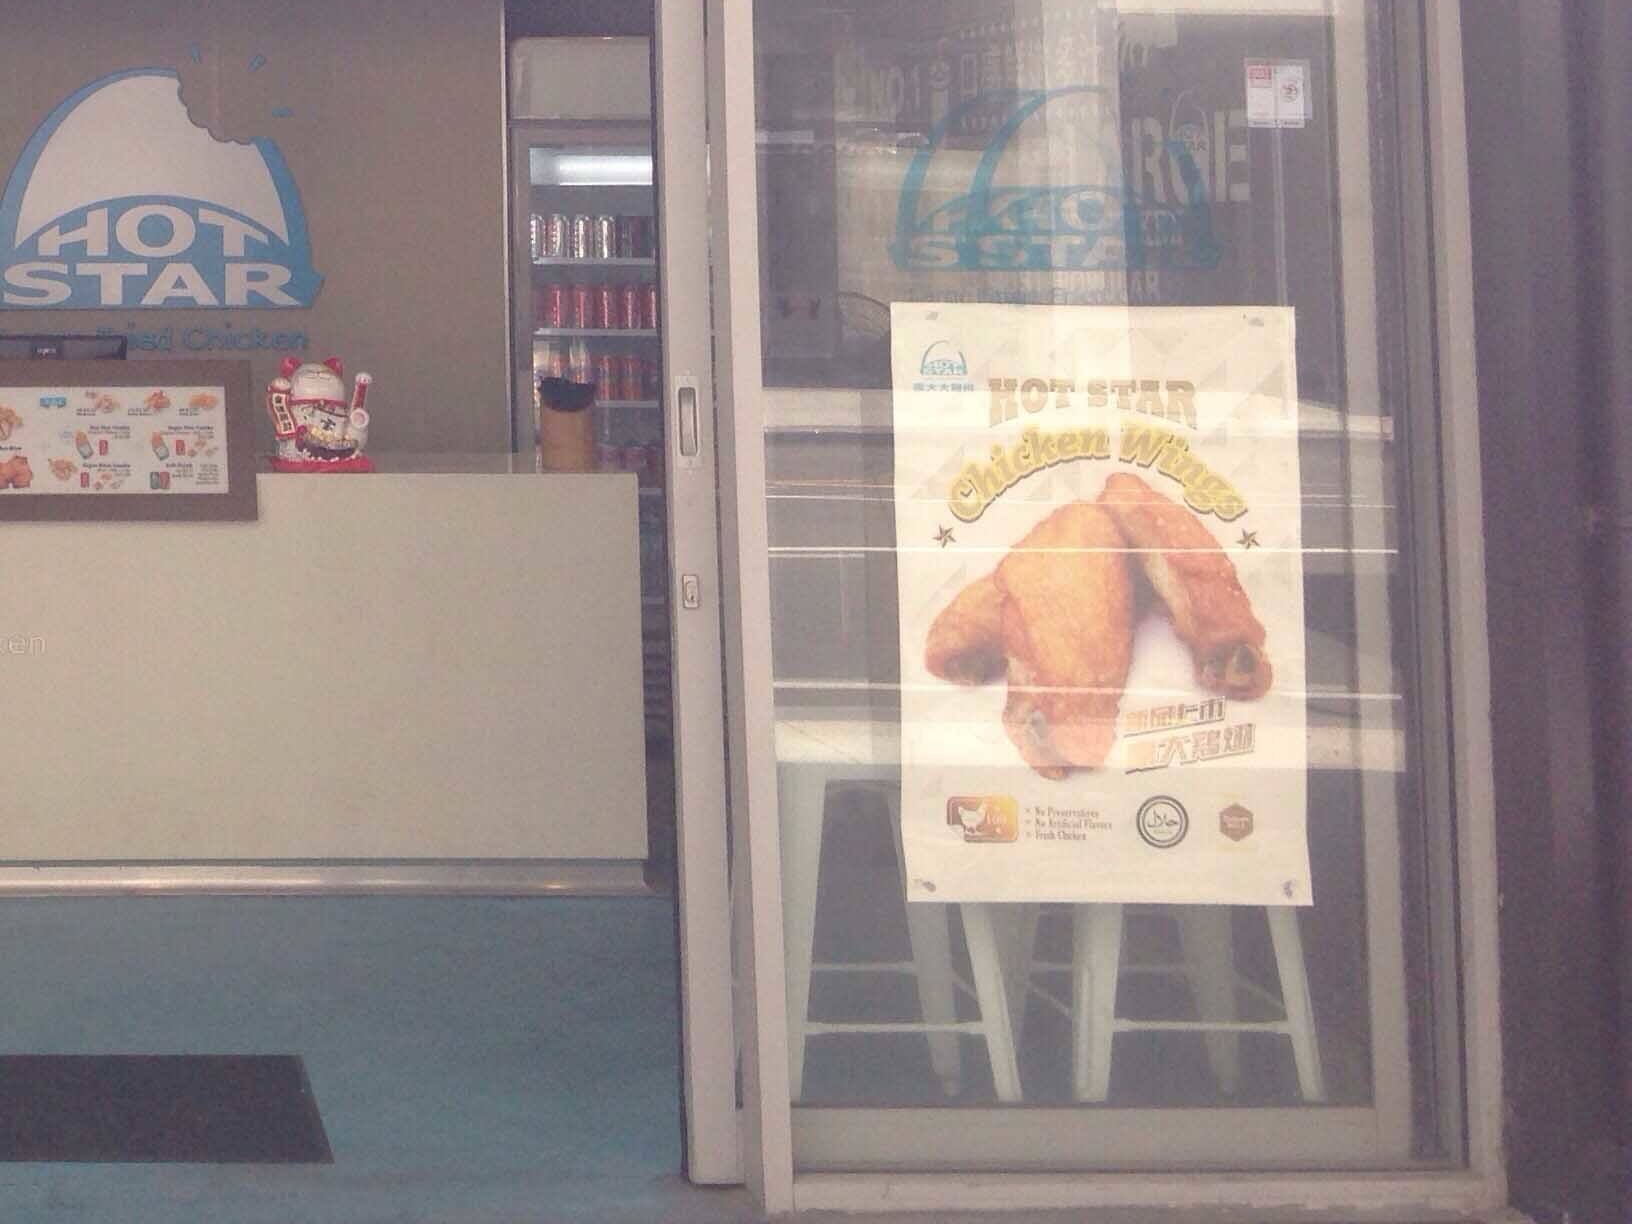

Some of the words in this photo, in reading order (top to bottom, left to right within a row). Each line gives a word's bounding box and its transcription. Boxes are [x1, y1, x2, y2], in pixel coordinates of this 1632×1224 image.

[37, 203, 269, 257] HOT
[3, 262, 303, 305] STAR
[988, 377, 1076, 428] HOT
[1087, 378, 1198, 430] STAR
[948, 423, 1111, 523] Chicken
[1119, 421, 1249, 523] Wings
